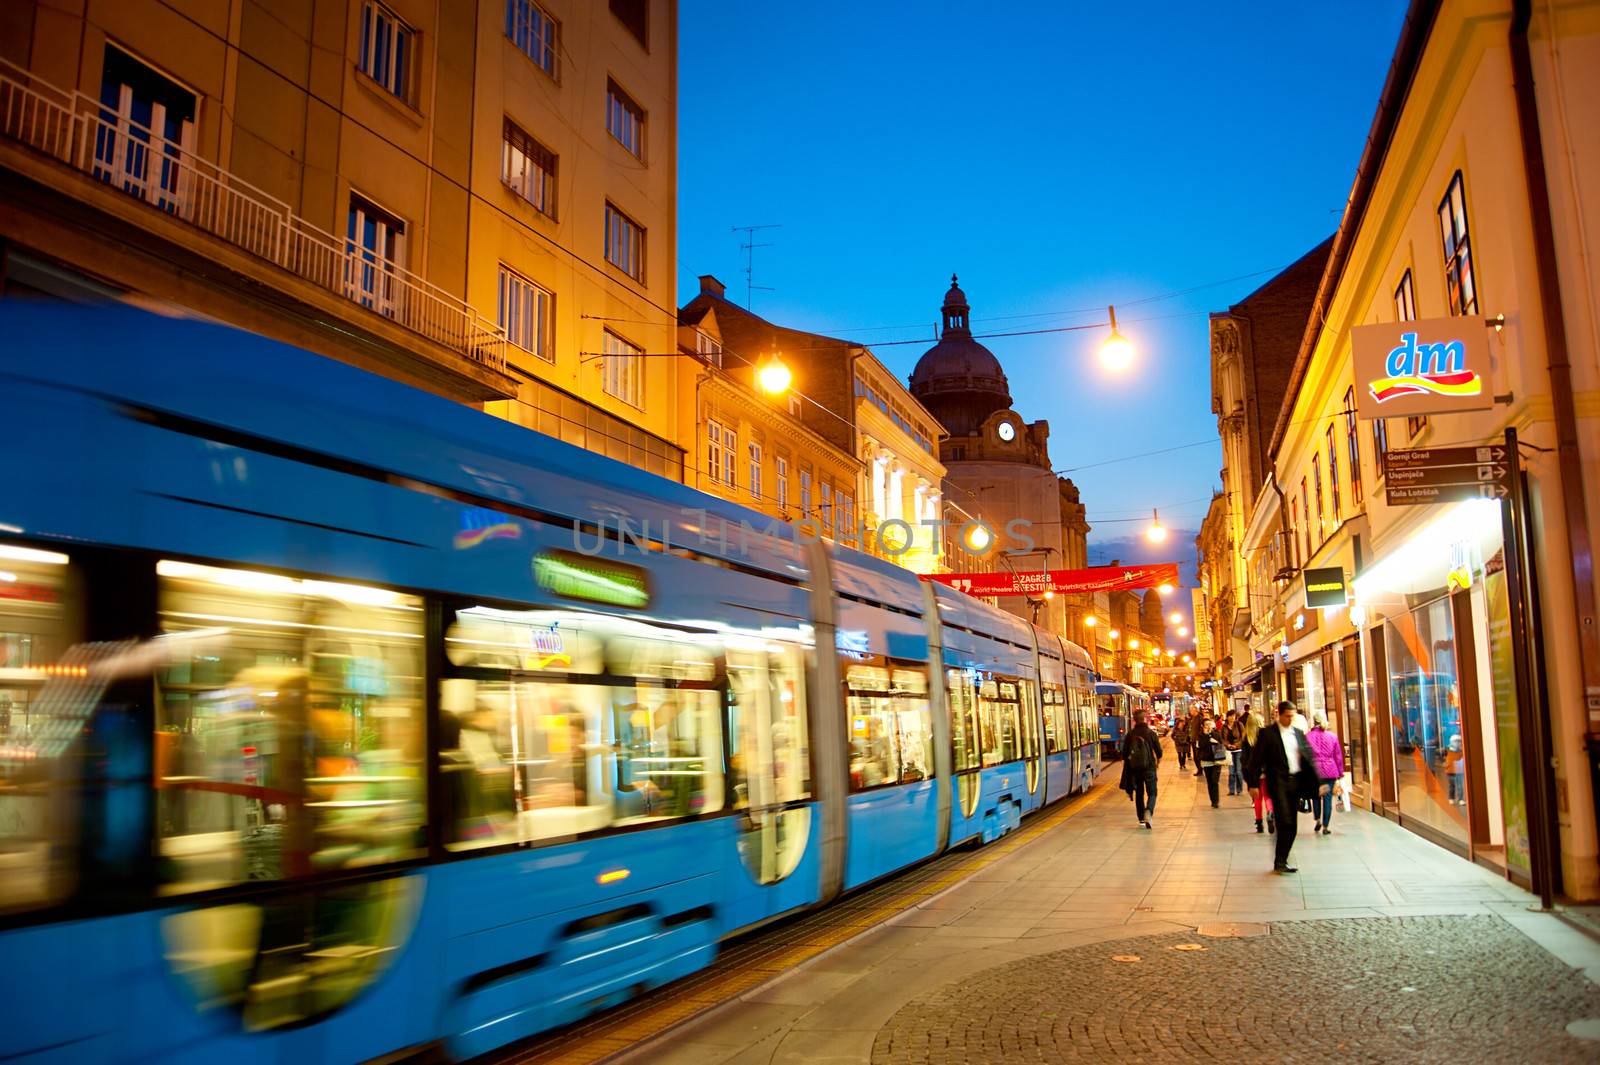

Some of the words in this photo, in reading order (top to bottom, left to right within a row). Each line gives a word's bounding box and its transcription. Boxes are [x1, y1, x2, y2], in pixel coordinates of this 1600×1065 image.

[1386, 332, 1465, 378] dm
[1388, 453, 1410, 461] Gornji
[1411, 451, 1430, 460] Grad
[1390, 489, 1407, 497] Kula
[1020, 574, 1052, 583] ZAGREB
[1020, 583, 1058, 592] FESTIVAL
